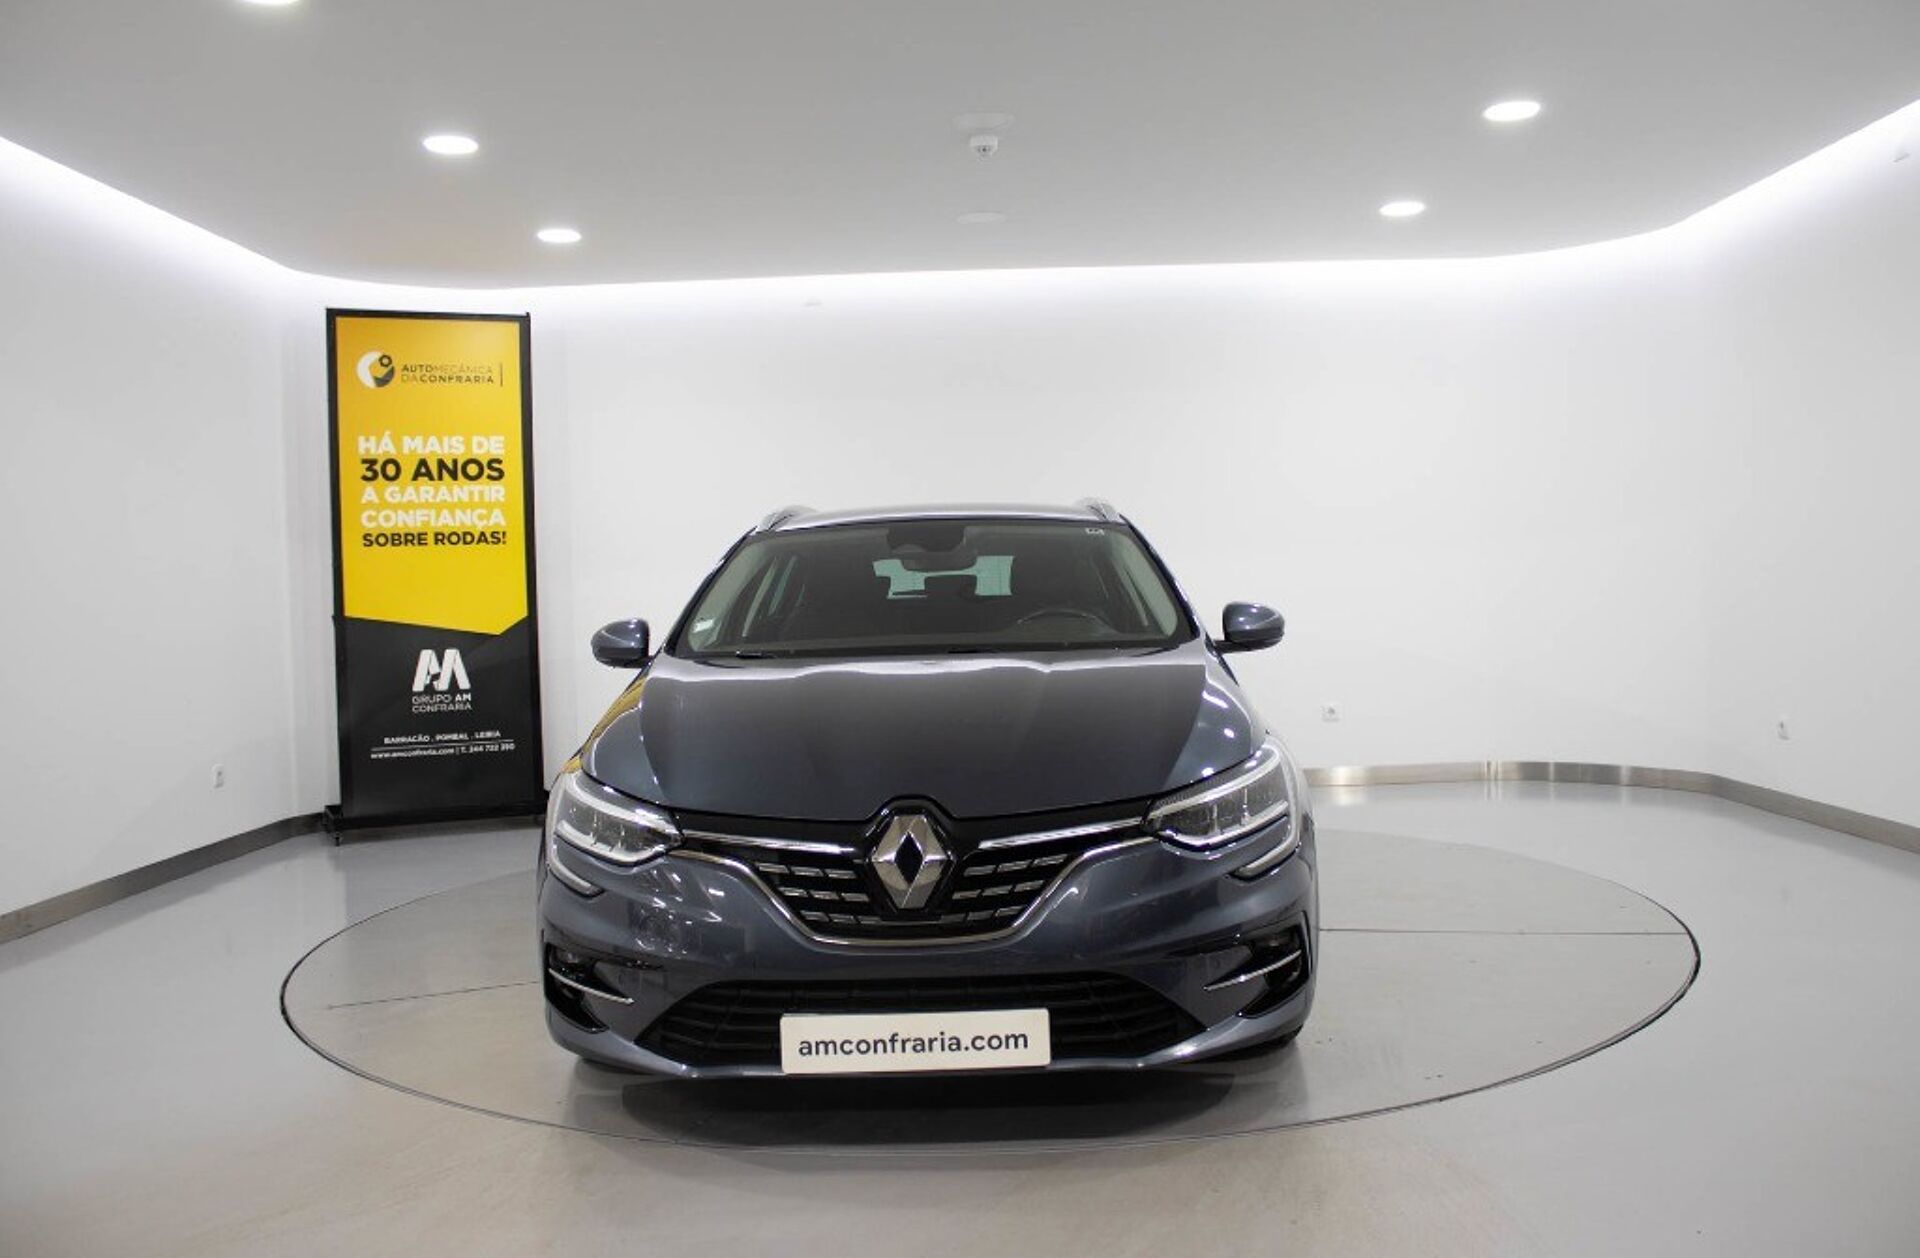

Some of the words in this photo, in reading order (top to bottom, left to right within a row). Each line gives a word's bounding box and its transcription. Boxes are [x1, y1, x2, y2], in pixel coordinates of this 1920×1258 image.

[401, 362, 493, 374] AUTOMECÂNICA
[357, 431, 396, 455] HÁ
[402, 436, 465, 454] MAIS
[472, 436, 505, 454] DE
[360, 458, 402, 481] 30
[411, 458, 505, 481] ANOS
[361, 487, 379, 504] A
[384, 486, 505, 503] GARANTIR
[361, 508, 506, 529] CONFIANÇA
[363, 532, 428, 547] SOBRE
[434, 531, 507, 545] RODAS!
[412, 694, 452, 704] GRUPO
[455, 693, 472, 702] AM
[412, 702, 472, 713] CONFRARIA
[798, 1031, 1029, 1056] amconfraria.com
